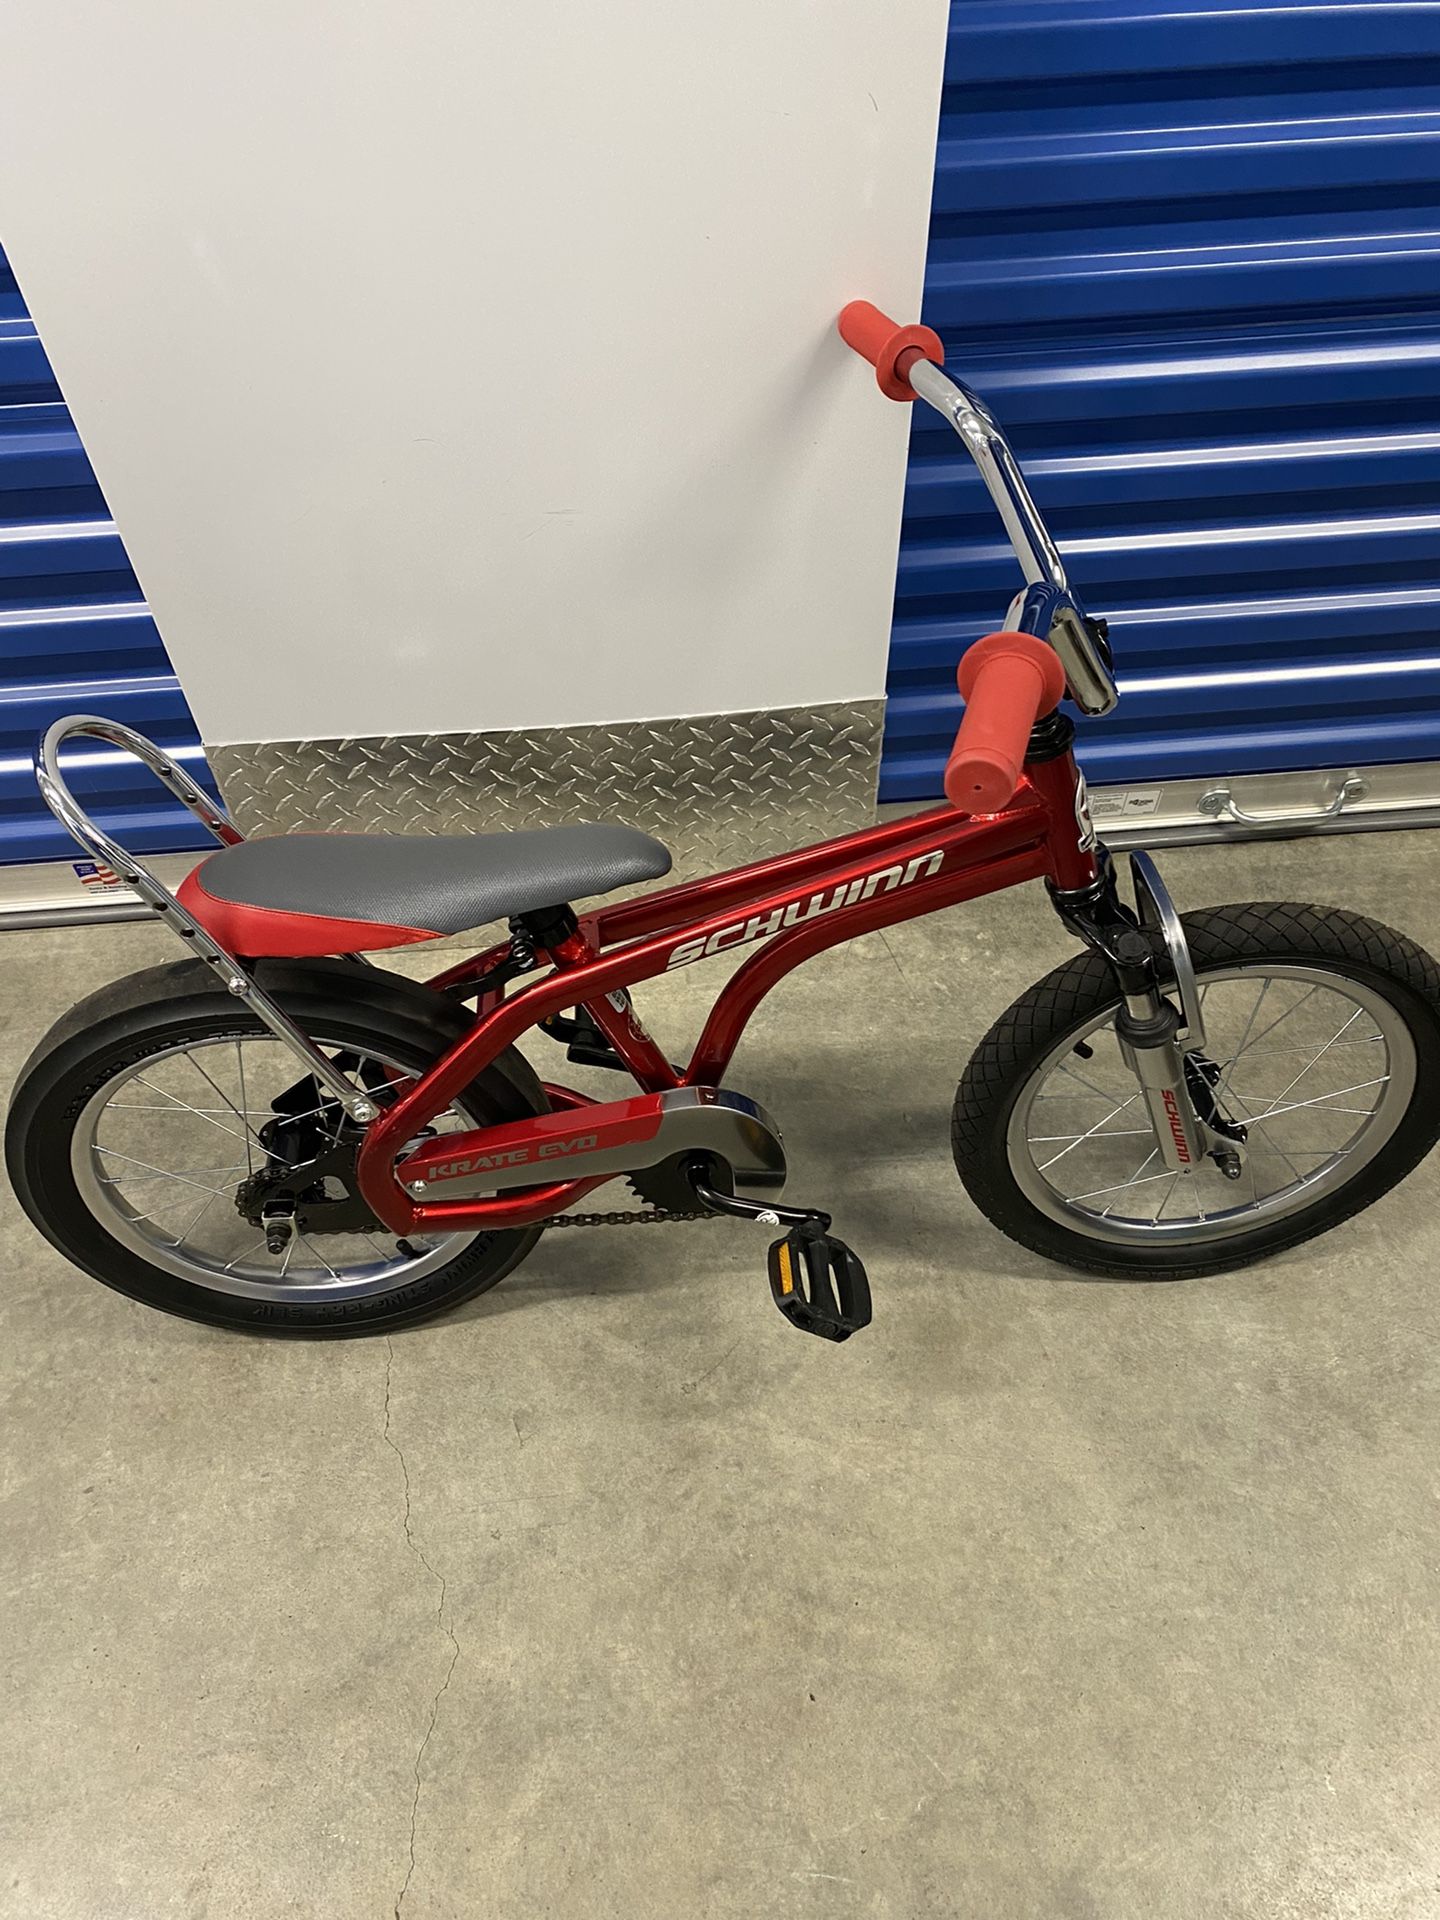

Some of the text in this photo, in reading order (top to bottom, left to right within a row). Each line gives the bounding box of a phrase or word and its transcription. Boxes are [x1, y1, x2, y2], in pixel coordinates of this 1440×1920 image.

[666, 849, 945, 971] SCHWINN
[428, 1134, 598, 1179] KRATE EVO
[1161, 1089, 1191, 1164] SCHWINN
